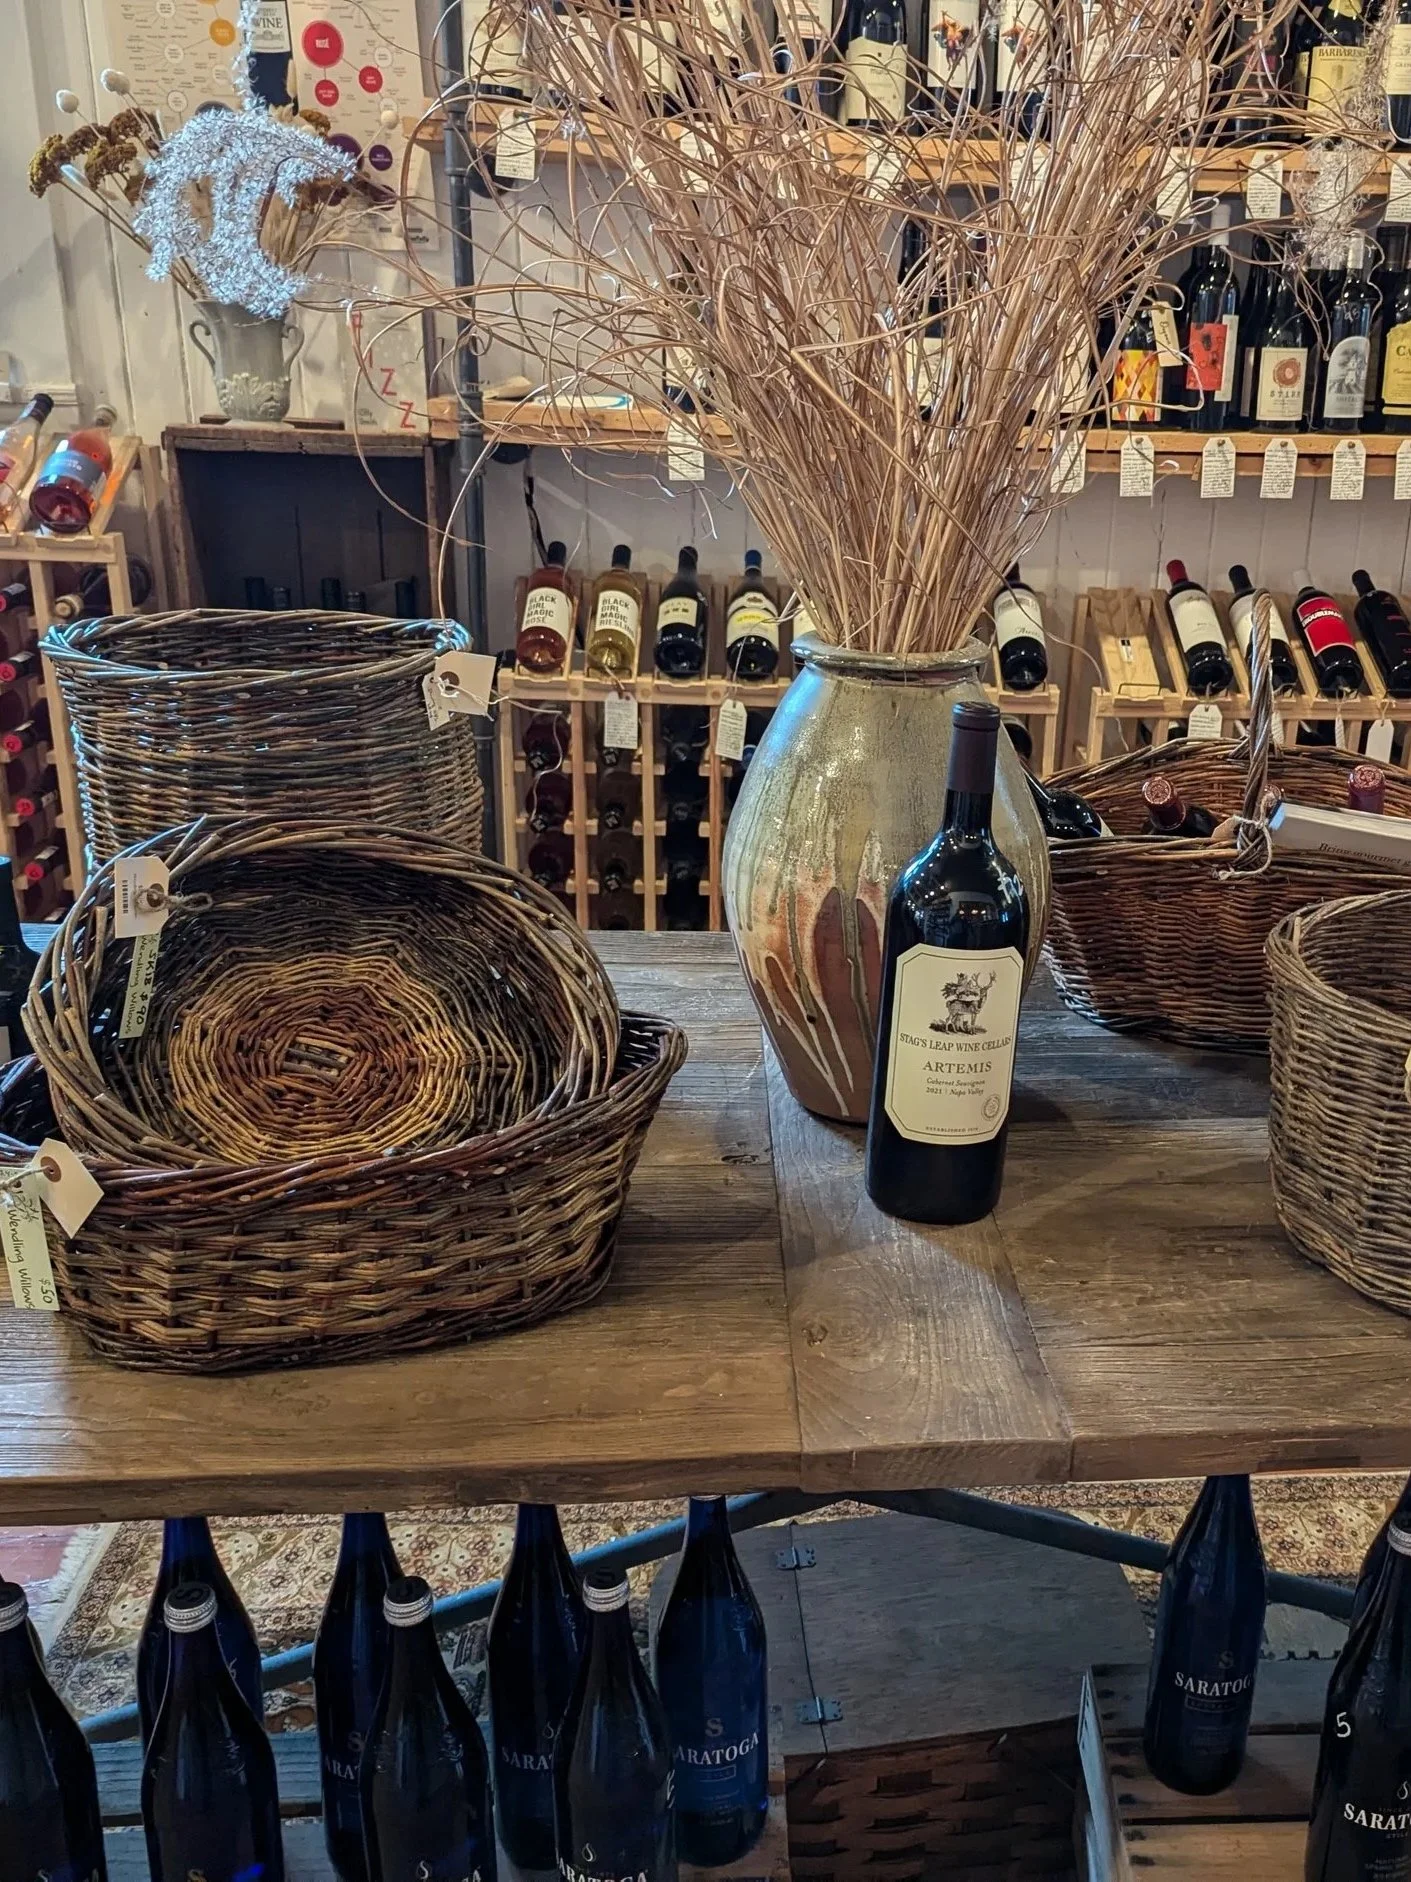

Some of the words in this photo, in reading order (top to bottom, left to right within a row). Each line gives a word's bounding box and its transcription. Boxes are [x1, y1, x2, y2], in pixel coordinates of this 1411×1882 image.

[1318, 48, 1368, 58] BARBARES
[529, 595, 557, 604] BLACK
[602, 598, 630, 610] BLACK
[527, 603, 546, 611] GIRL
[601, 605, 620, 613] GIRL
[526, 609, 554, 618] MAGIC
[600, 612, 628, 623] MAGIC
[900, 1032, 927, 1048] STAG'S
[929, 1040, 954, 1052] LEAP
[956, 1042, 981, 1052] WINE
[982, 1035, 1012, 1052] CELLARS
[922, 1060, 992, 1074] ARTEMIS
[926, 1077, 955, 1086] Cabernet
[926, 1087, 942, 1095] 2021
[949, 1088, 966, 1097] Napa
[967, 1088, 984, 1097] Valley
[8, 1209, 24, 1263] Wendling
[18, 1268, 35, 1310] Willows
[39, 1278, 53, 1304] $50
[1336, 1711, 1351, 1738] 5
[1344, 1802, 1411, 1831] SARAT
